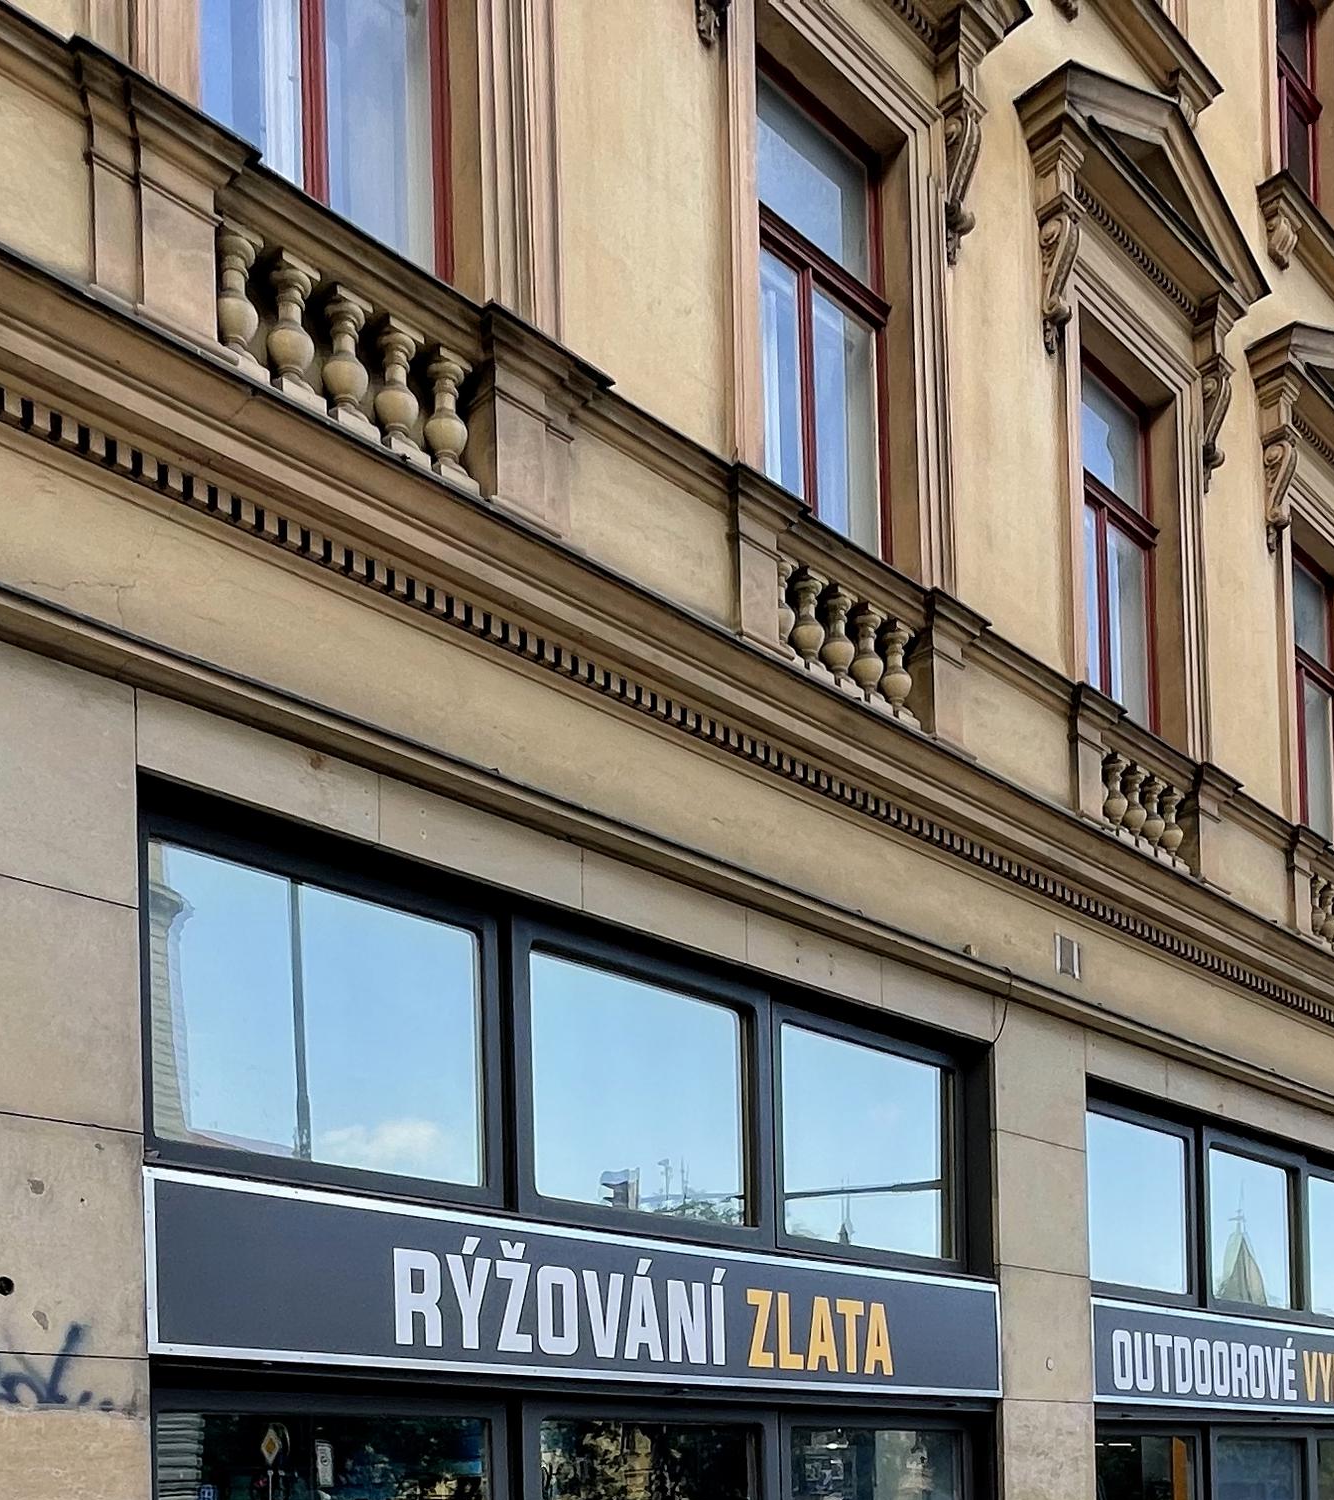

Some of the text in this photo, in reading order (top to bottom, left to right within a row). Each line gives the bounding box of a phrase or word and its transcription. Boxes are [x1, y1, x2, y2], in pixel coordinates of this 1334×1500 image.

[393, 1236, 894, 1376] RÝŽOVÁNÍ ZLATA
[1112, 1329, 1298, 1401] OUTDOOROVÉ
